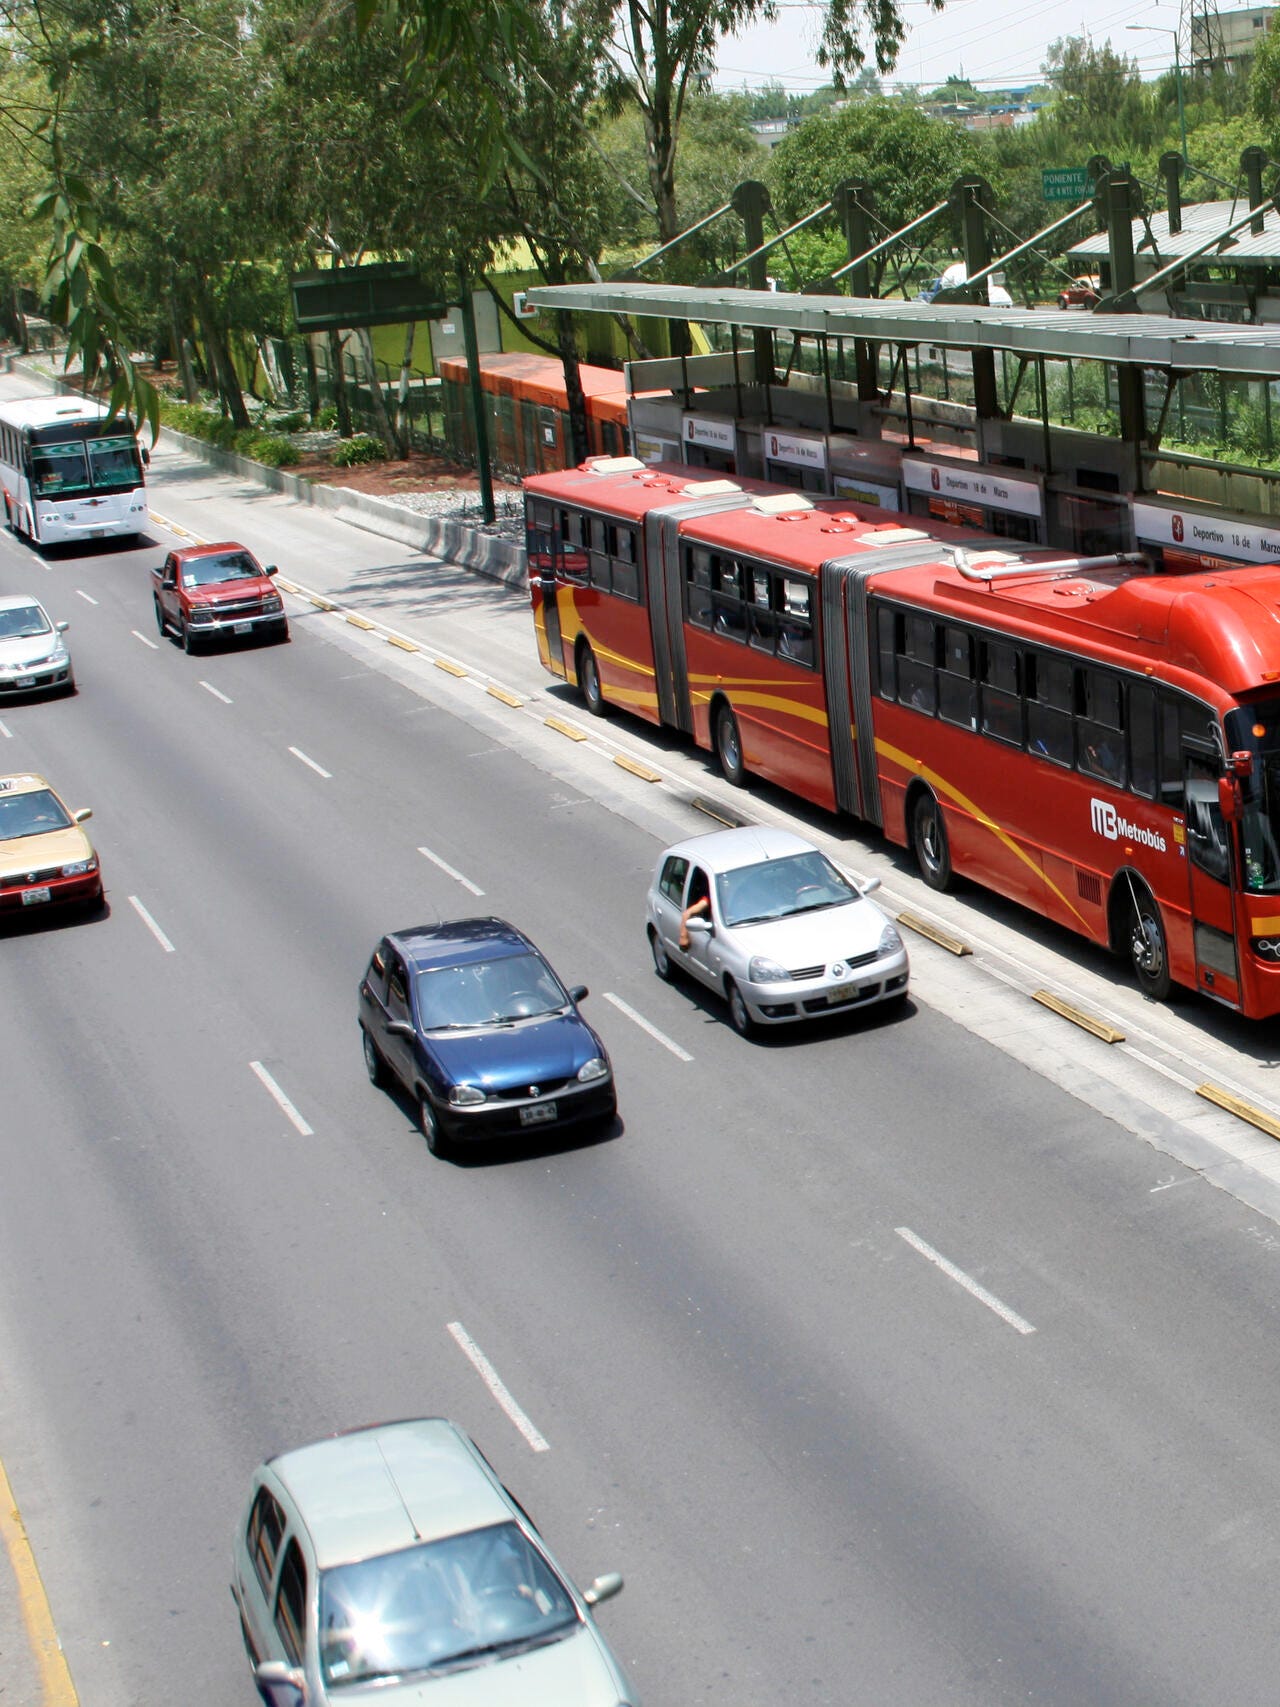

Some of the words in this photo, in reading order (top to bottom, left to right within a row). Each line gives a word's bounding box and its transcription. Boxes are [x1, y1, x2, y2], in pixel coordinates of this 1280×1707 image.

[1043, 173, 1082, 184] PONIENTE
[1193, 525, 1224, 543] Deportivo
[1231, 534, 1240, 546] 18
[1242, 536, 1251, 549] de
[1117, 816, 1167, 853] Metrobús
